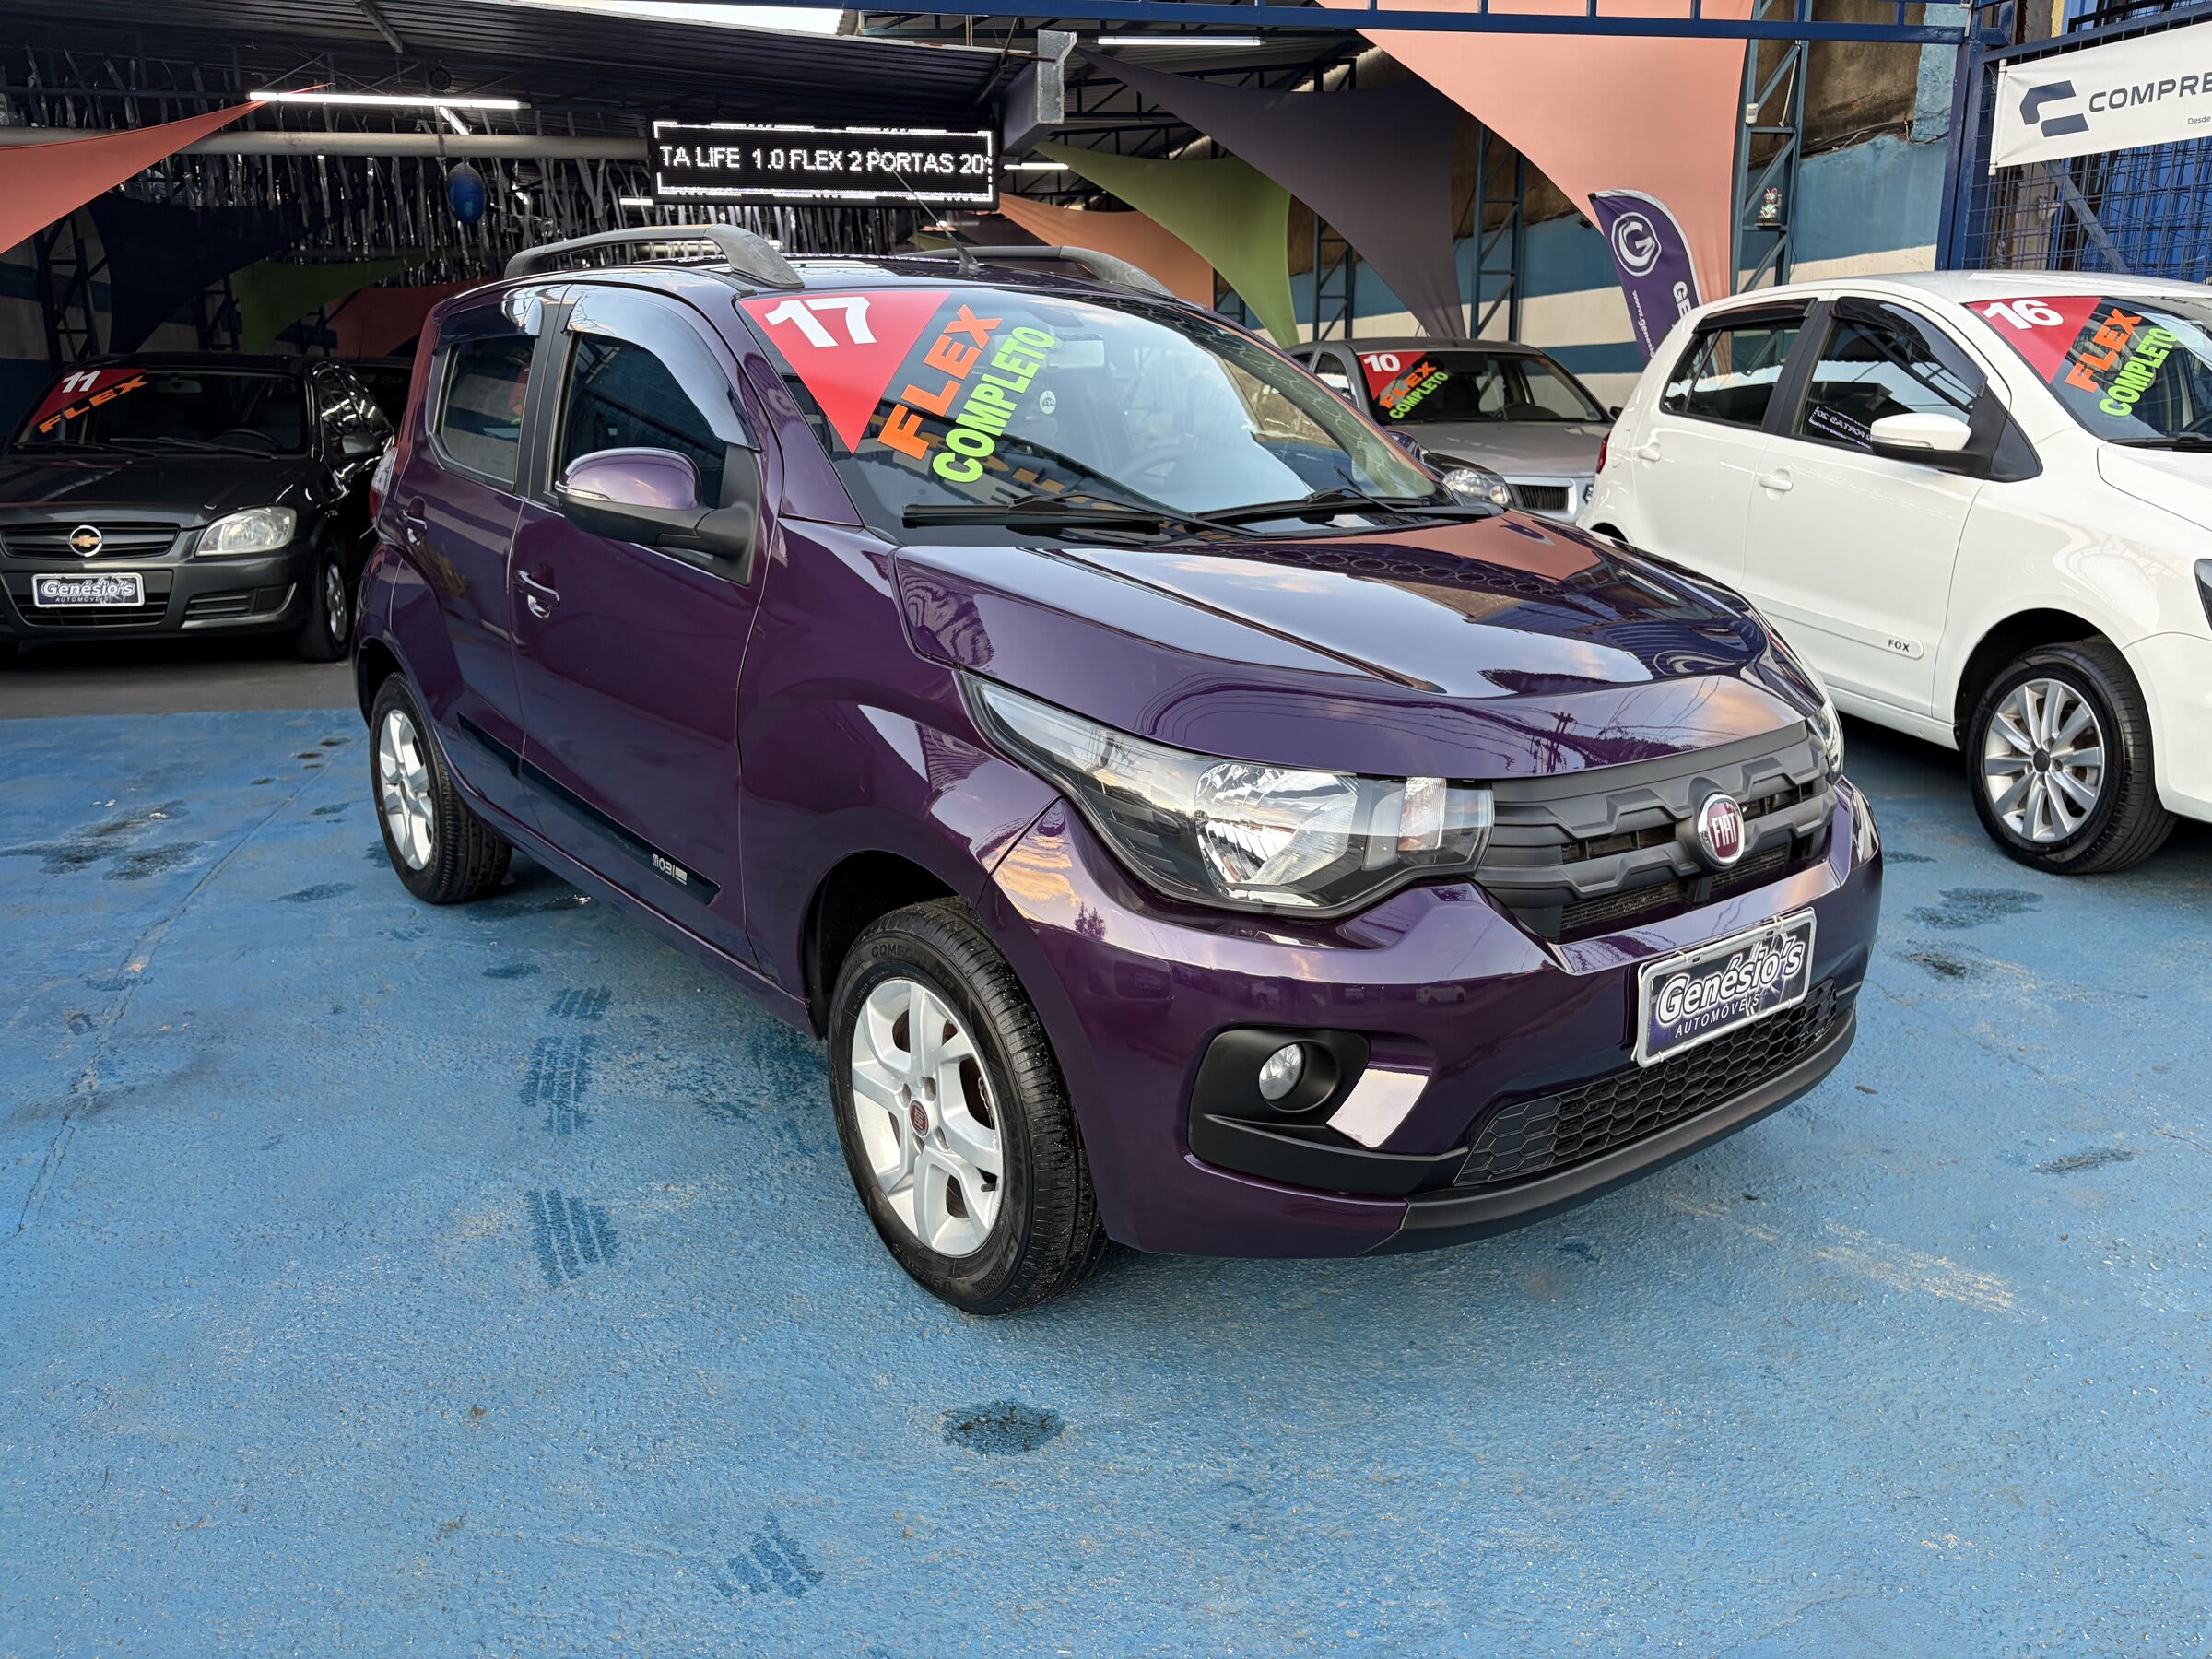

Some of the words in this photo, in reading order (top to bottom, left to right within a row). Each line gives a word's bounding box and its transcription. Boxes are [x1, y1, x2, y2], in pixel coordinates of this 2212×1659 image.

[2187, 114, 2211, 125] Desde
[659, 146, 690, 167] TA
[696, 147, 740, 169] LIFE
[752, 147, 784, 170] 1.0
[789, 148, 843, 171] FLEX
[847, 150, 862, 171] 2
[867, 151, 954, 174] PORTAS
[763, 296, 877, 348] 17
[1982, 300, 2065, 330] 16
[1363, 354, 1401, 373] 10
[2065, 308, 2143, 394] FLEX
[2099, 327, 2180, 417] COMPLETO
[39, 375, 148, 434] FLEX
[61, 370, 102, 394] 11
[877, 304, 1003, 459] FLEX
[933, 326, 1056, 483] COMPLETO
[1379, 361, 1437, 409] FLEX
[1388, 371, 1449, 419] COMPLETO
[41, 579, 135, 597] Genésio's
[1888, 639, 1910, 653] FOX
[1710, 813, 1738, 848] FIAT
[1658, 936, 1806, 1025] Genésio's
